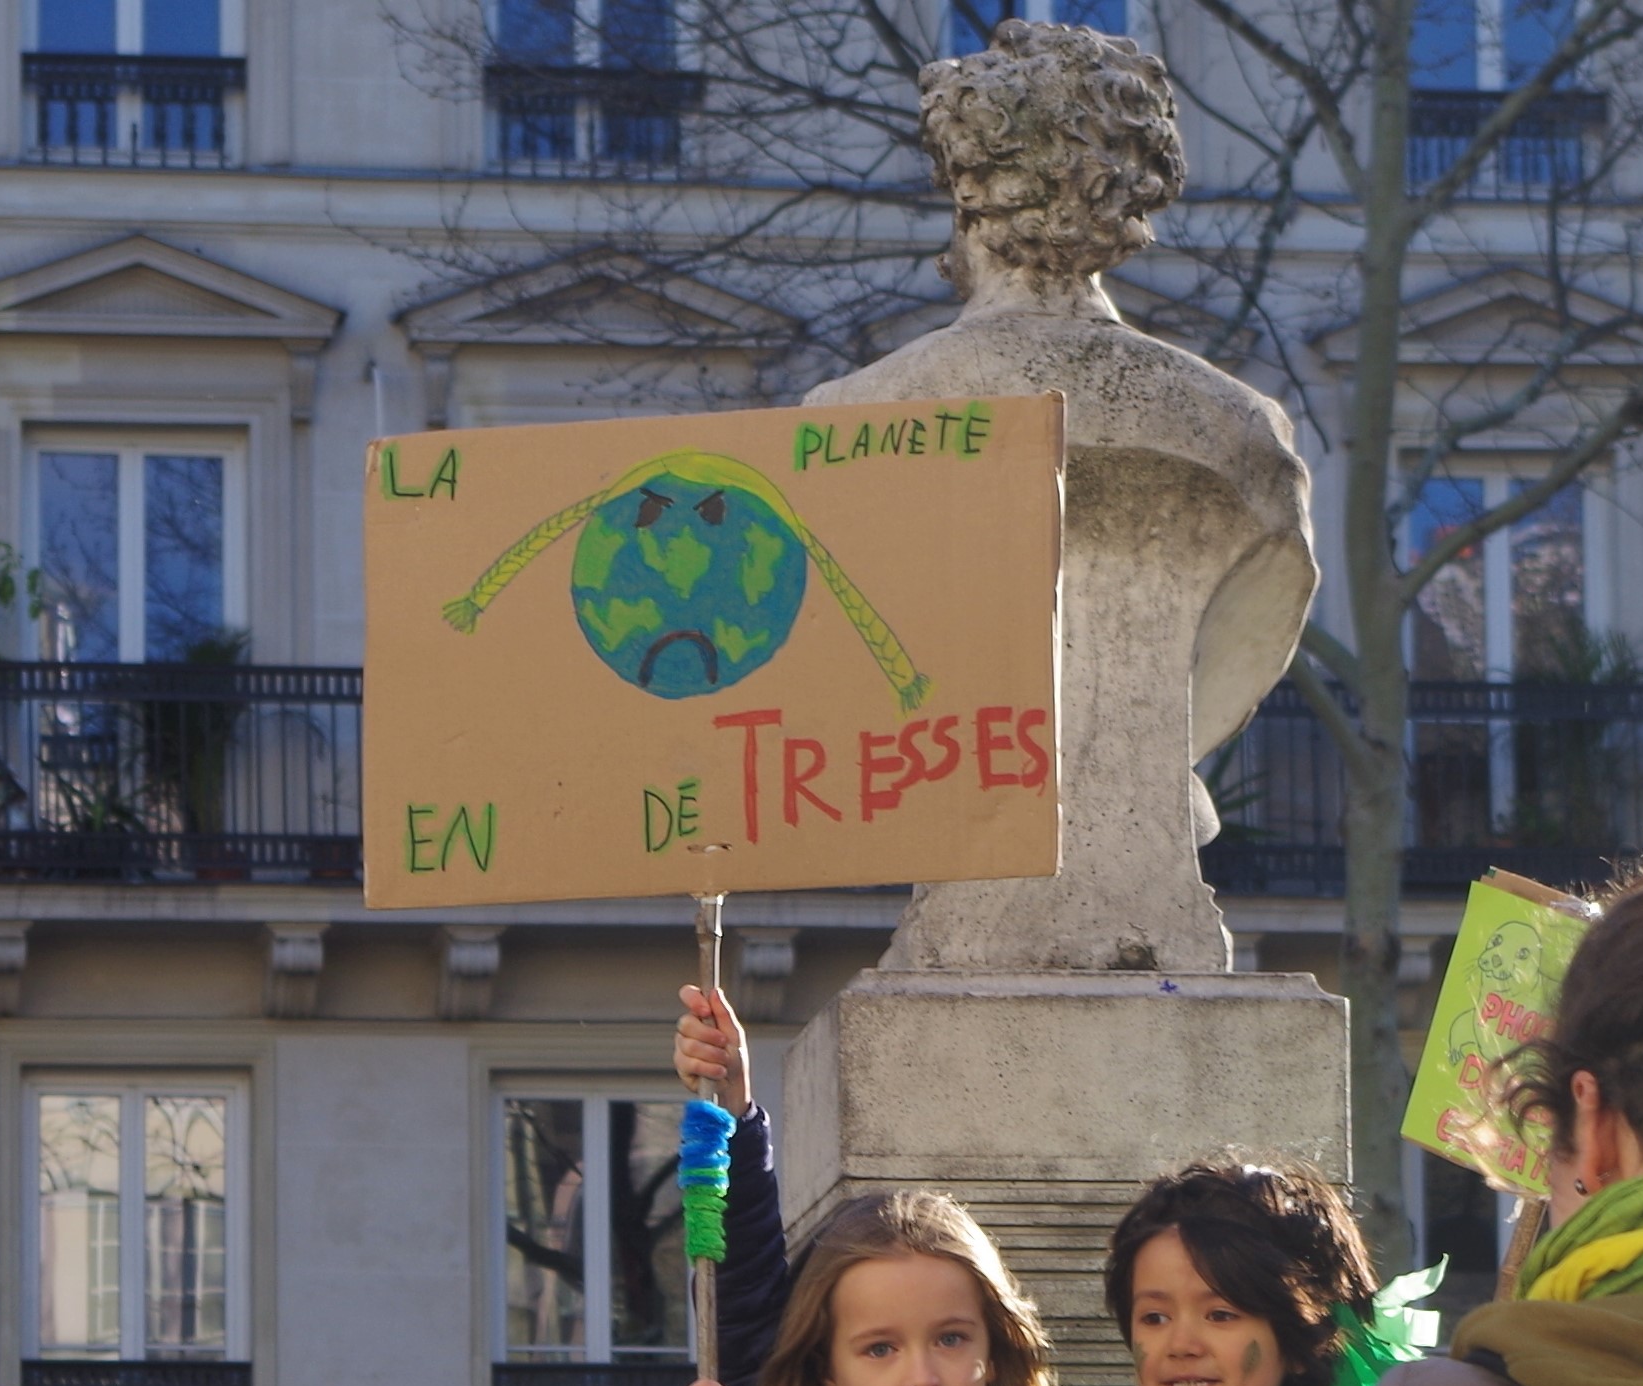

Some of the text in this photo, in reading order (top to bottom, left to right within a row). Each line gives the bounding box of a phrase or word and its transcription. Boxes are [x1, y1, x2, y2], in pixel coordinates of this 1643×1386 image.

[388, 448, 457, 501] LA
[407, 802, 493, 873] EN
[712, 706, 1050, 845] TRESSES
